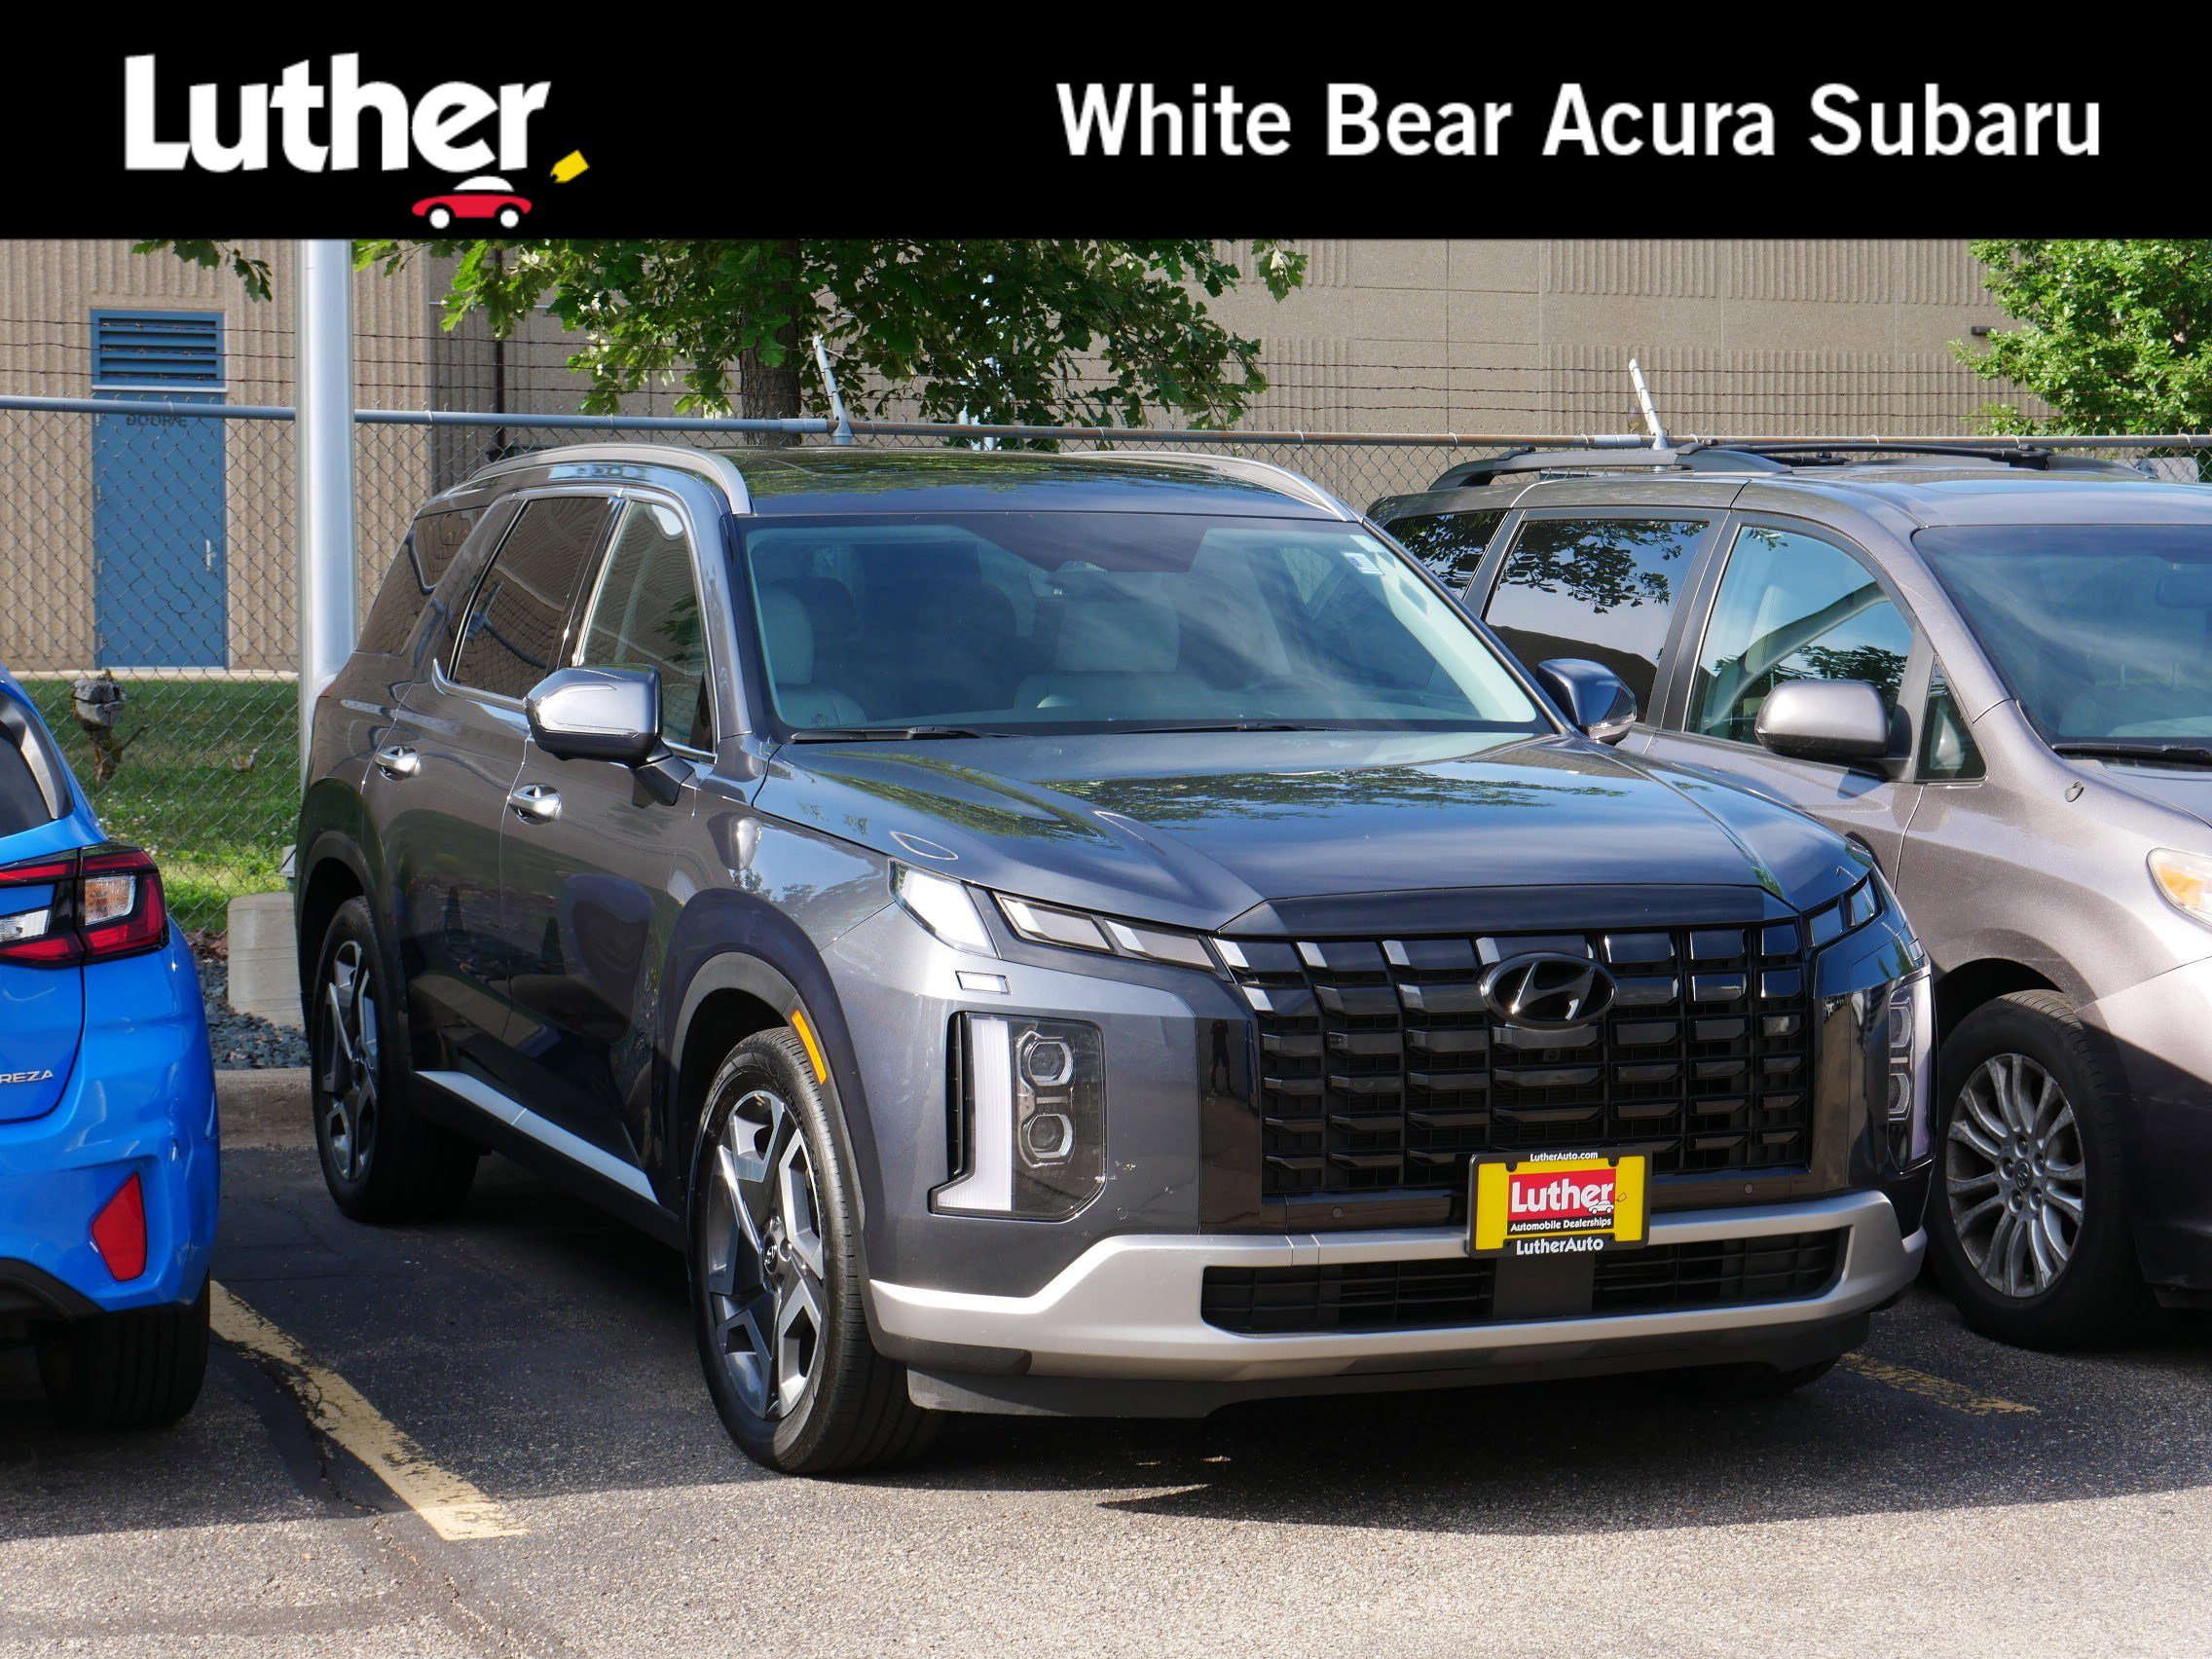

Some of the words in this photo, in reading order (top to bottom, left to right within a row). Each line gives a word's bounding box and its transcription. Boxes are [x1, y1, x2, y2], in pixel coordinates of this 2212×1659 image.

[1530, 1152, 1599, 1162] LutherAuto.com
[1511, 1178, 1614, 1213] Luther
[1510, 1219, 1562, 1233] Automobile
[1563, 1217, 1612, 1230] Dealerships
[1516, 1235, 1604, 1256] LutherAuto
